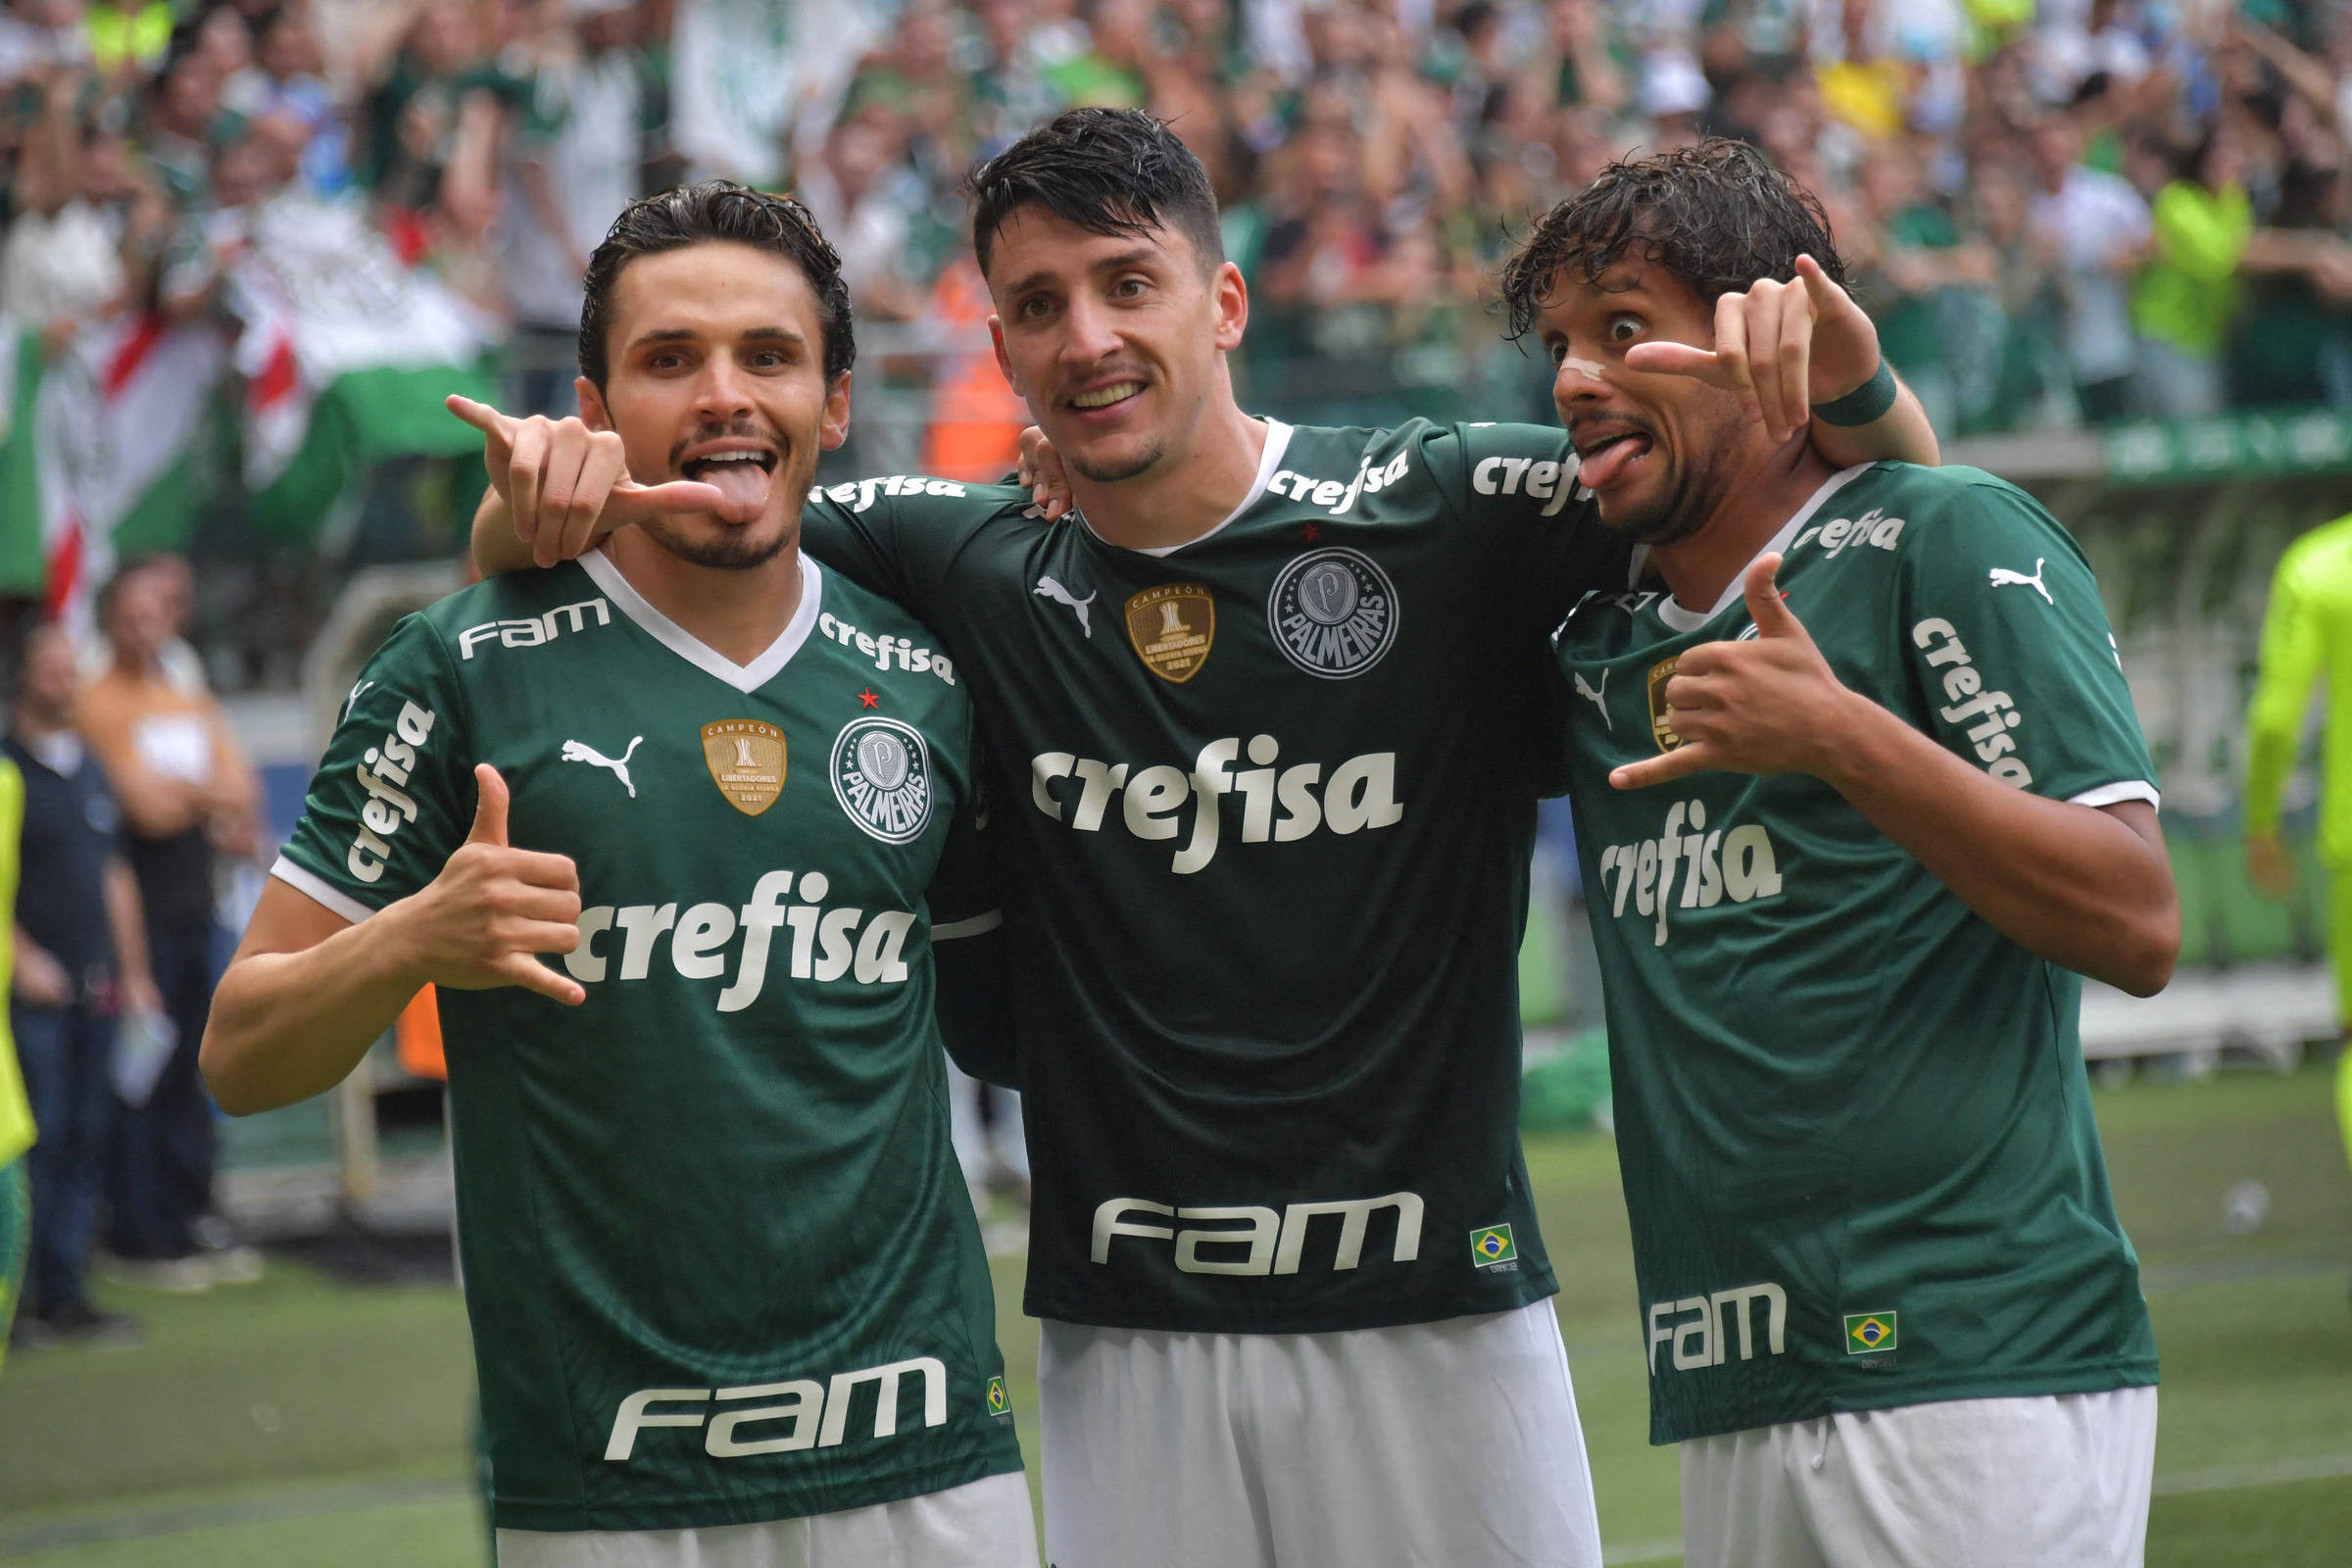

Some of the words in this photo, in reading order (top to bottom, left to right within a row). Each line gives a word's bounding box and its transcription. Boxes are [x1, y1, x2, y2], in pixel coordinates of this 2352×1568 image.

[1472, 452, 1593, 517] cref
[819, 612, 956, 686] crefisa
[1282, 595, 1386, 667] PALMEIRAS
[1912, 617, 2034, 790] crefisa
[347, 699, 436, 883] crefisa
[842, 770, 926, 833] PALMEIRAS
[1032, 733, 1403, 875] crefisa
[564, 869, 917, 1012] crefisa
[1599, 799, 1783, 948] crefisa
